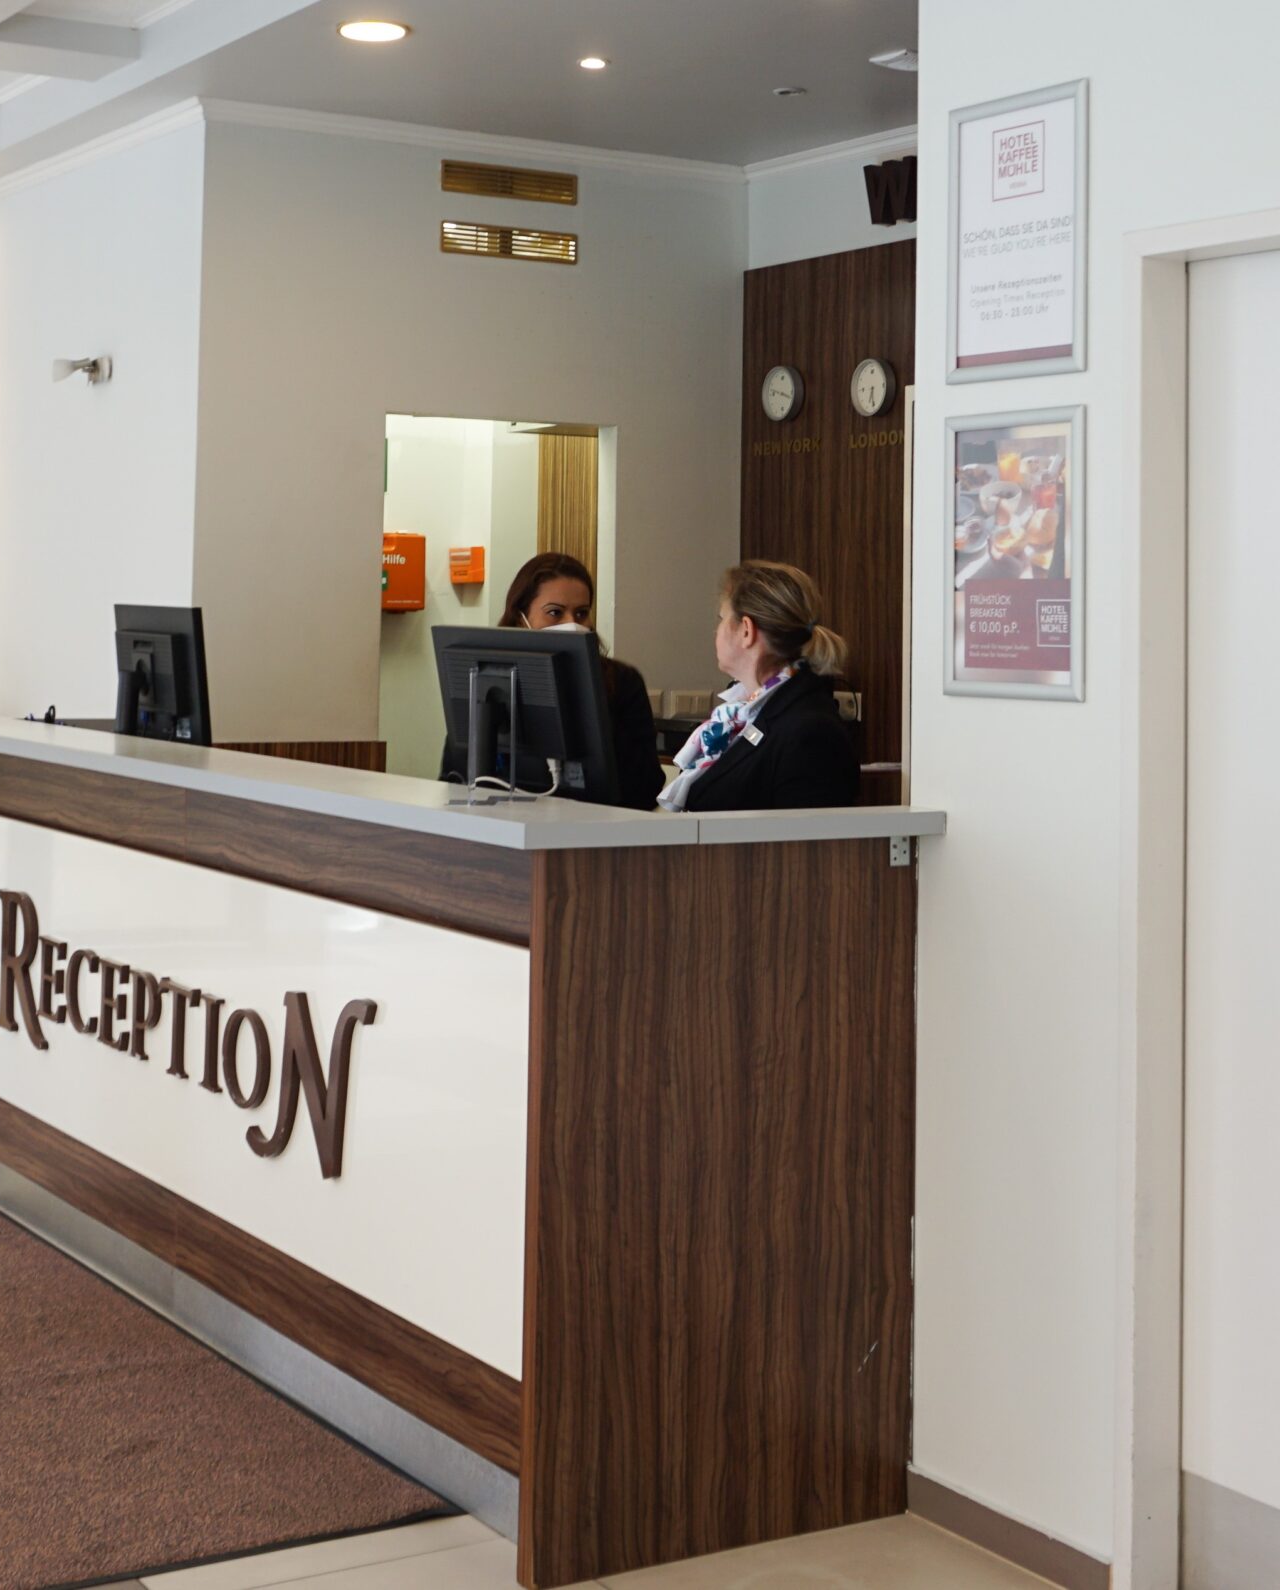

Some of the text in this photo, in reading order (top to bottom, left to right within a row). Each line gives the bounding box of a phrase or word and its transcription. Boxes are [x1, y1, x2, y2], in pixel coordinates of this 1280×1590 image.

[999, 132, 1037, 151] HOTEL
[998, 145, 1039, 165] KAFFEE
[997, 159, 1039, 178] MÜHLE
[999, 224, 1021, 239] DASS
[1022, 221, 1034, 234] SIE
[1036, 219, 1049, 232] DA
[990, 240, 1014, 255] GLAD
[754, 437, 820, 456] NEW YORK
[382, 553, 406, 565] Hilfe
[969, 593, 1011, 605] FRÜHSTÜCK
[969, 608, 1007, 618] BREAKFAST
[1041, 605, 1066, 614] HOTEL
[1040, 614, 1068, 624] KAFFEE
[969, 621, 977, 633] €
[978, 621, 1001, 634] 10,00
